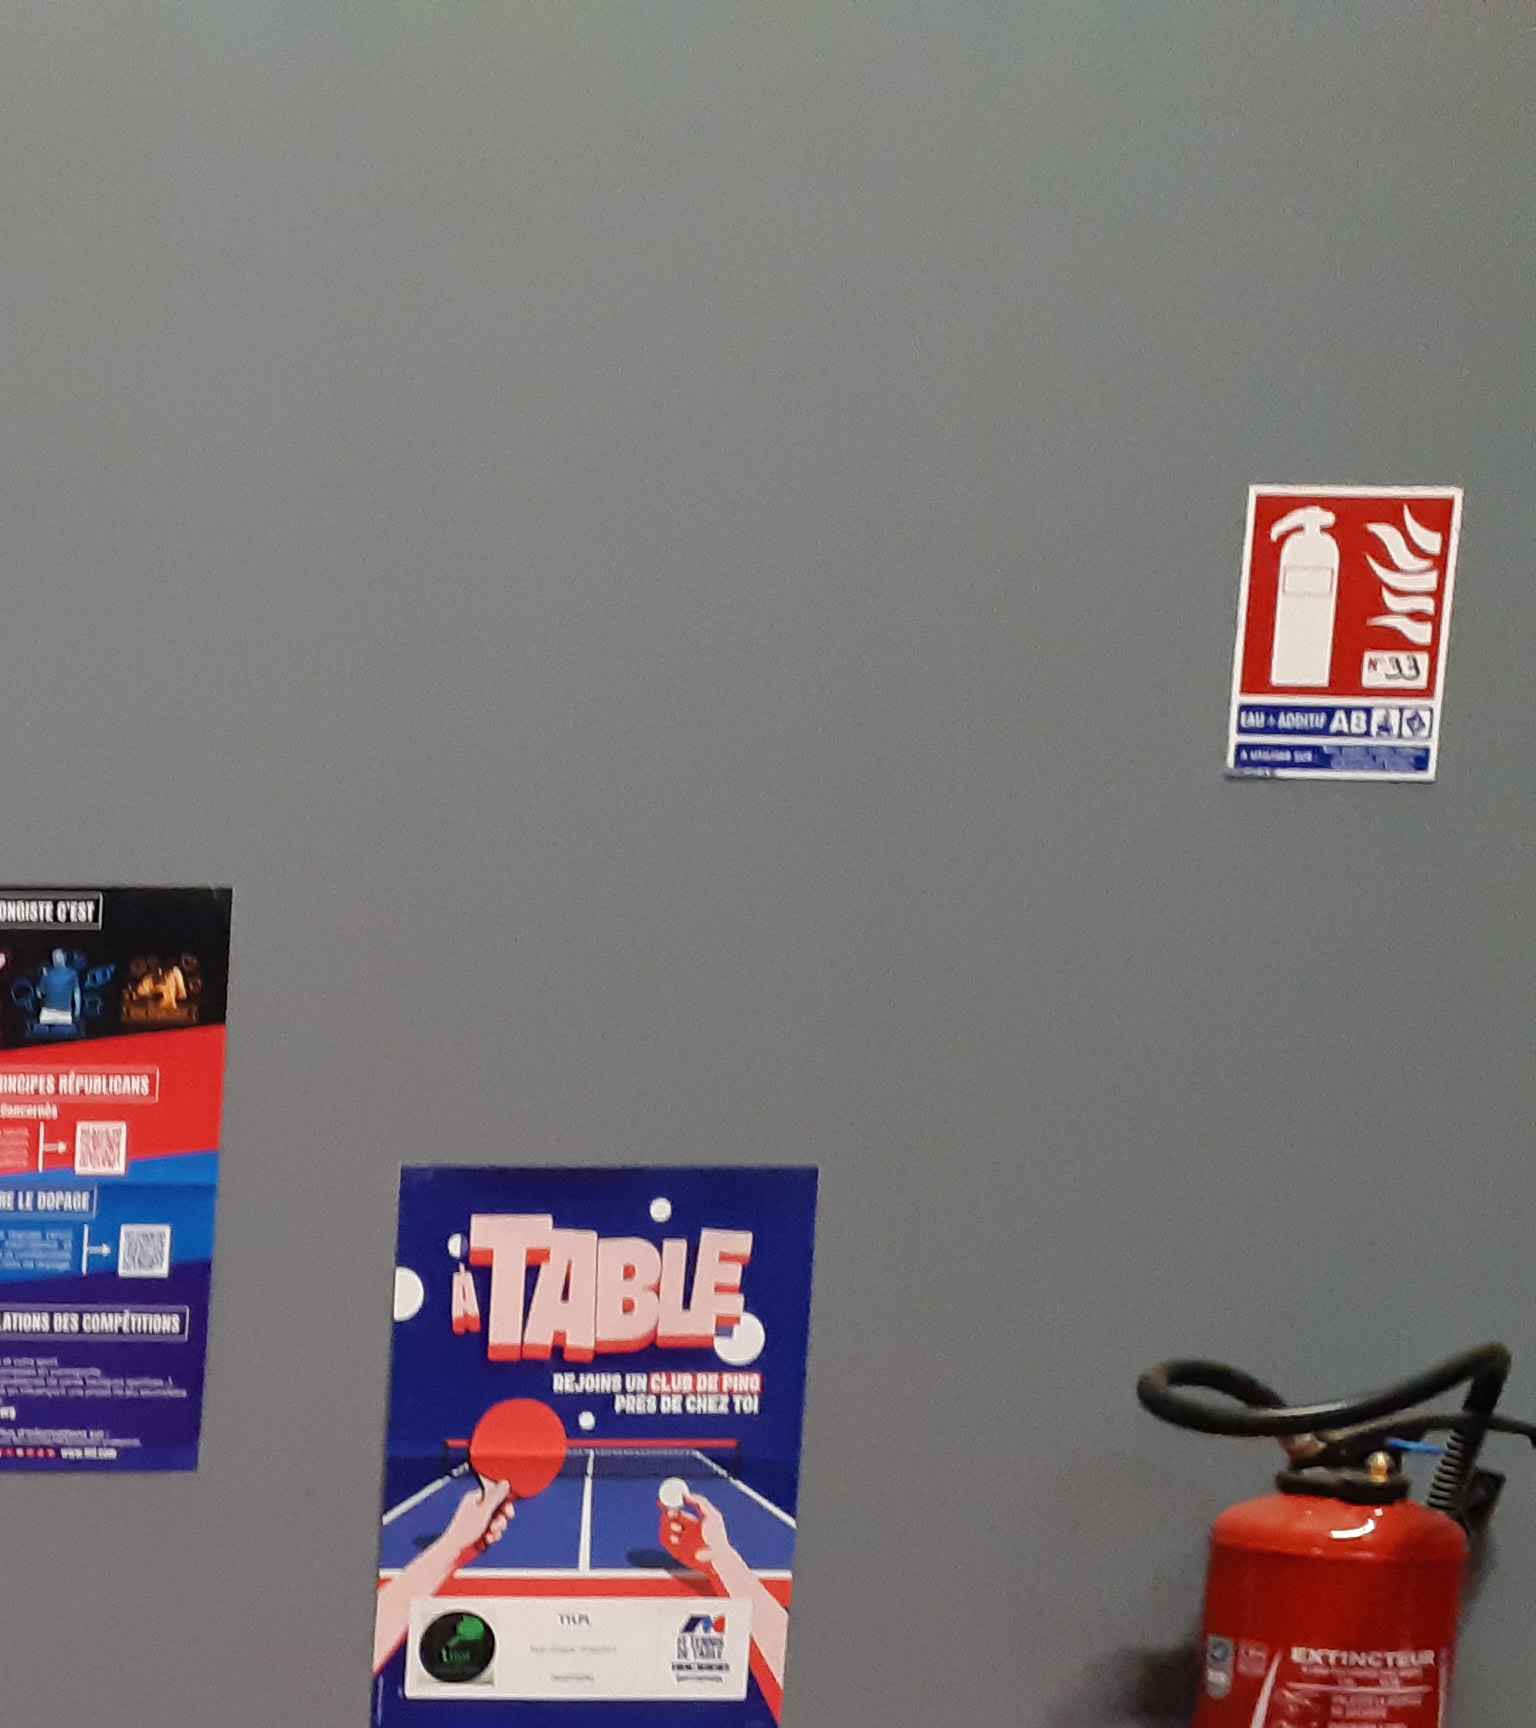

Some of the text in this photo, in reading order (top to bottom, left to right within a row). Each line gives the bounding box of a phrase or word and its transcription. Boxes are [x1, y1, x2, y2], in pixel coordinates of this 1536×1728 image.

[1240, 710, 1265, 728] EAU
[1278, 711, 1327, 729] ADDITIF
[17, 1190, 34, 1211] LE
[37, 1190, 90, 1212] DOPAGE
[469, 1213, 754, 1364] TABLE
[53, 1312, 79, 1332] DES
[82, 1308, 181, 1334] COMPÉTITIONS
[552, 1371, 761, 1394] REJOINS UN CLUB DE PING
[660, 1395, 684, 1415] DE
[686, 1395, 730, 1416] CHEZ
[1291, 1646, 1436, 1669] EXTINCTEUR
